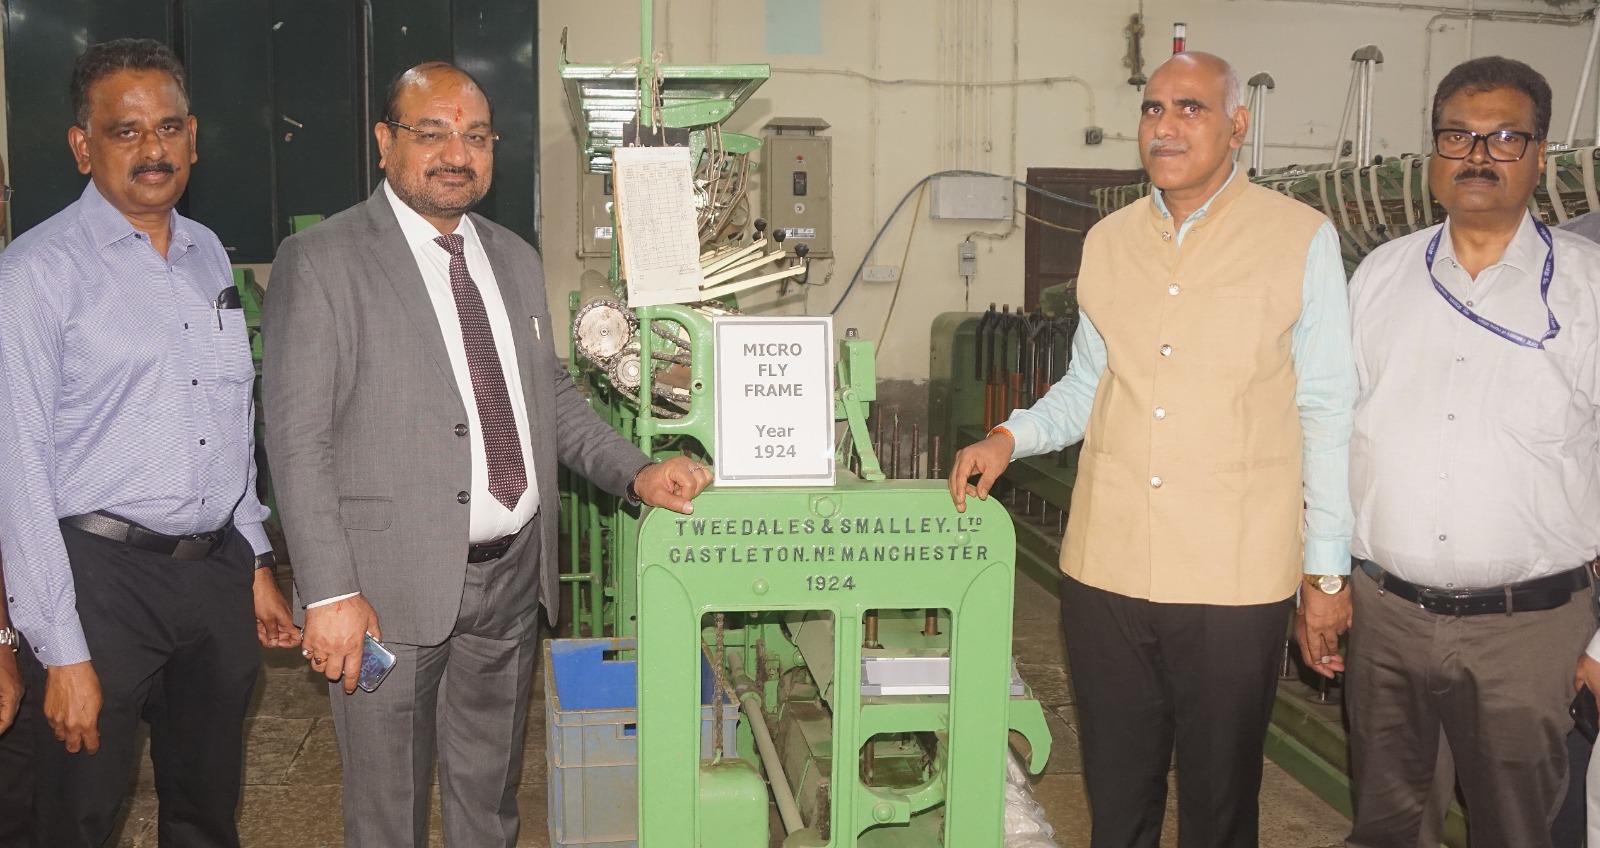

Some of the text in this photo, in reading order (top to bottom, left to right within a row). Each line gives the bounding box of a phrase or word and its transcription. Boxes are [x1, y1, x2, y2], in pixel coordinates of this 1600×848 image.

[743, 343, 802, 357] MICRO
[758, 364, 788, 376] FLY
[744, 384, 803, 397] FRAME
[755, 425, 794, 438] Year
[754, 445, 797, 458] 1924
[841, 545, 988, 562] MANCHESTER
[806, 575, 856, 591] 1924
